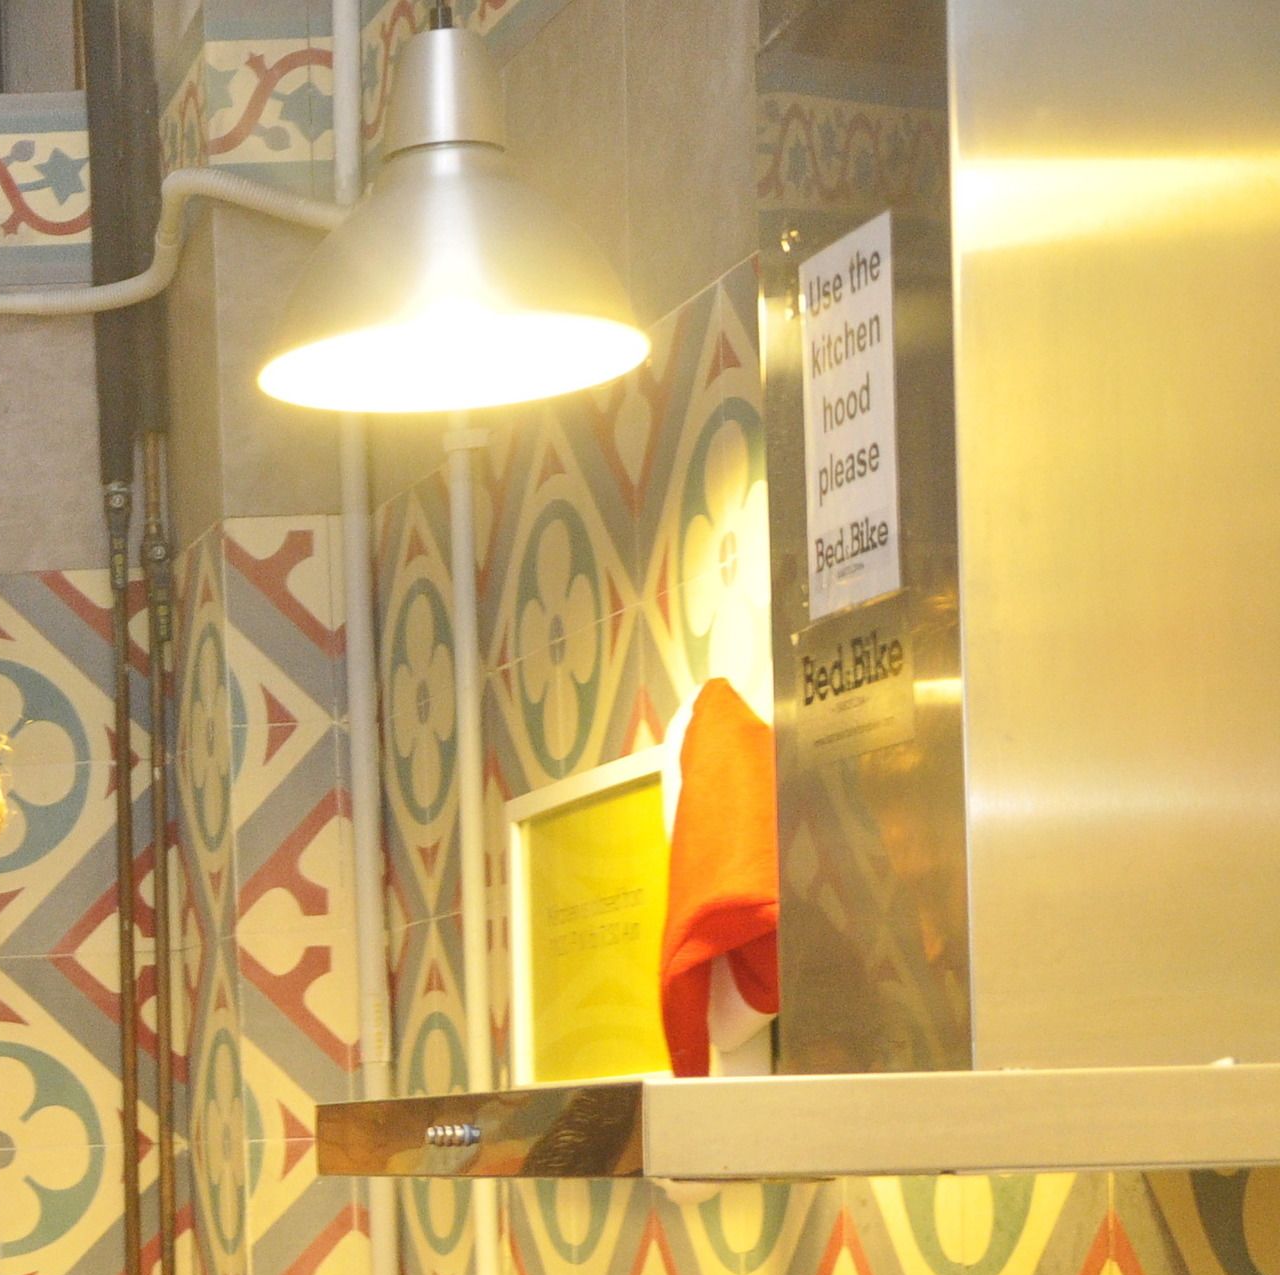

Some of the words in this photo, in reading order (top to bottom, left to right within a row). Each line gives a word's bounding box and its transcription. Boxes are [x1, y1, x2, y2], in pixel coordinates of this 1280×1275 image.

[809, 272, 843, 318] Use
[849, 249, 881, 294] the
[811, 313, 881, 380] kitchen
[823, 371, 871, 434] hood
[819, 441, 881, 507] please
